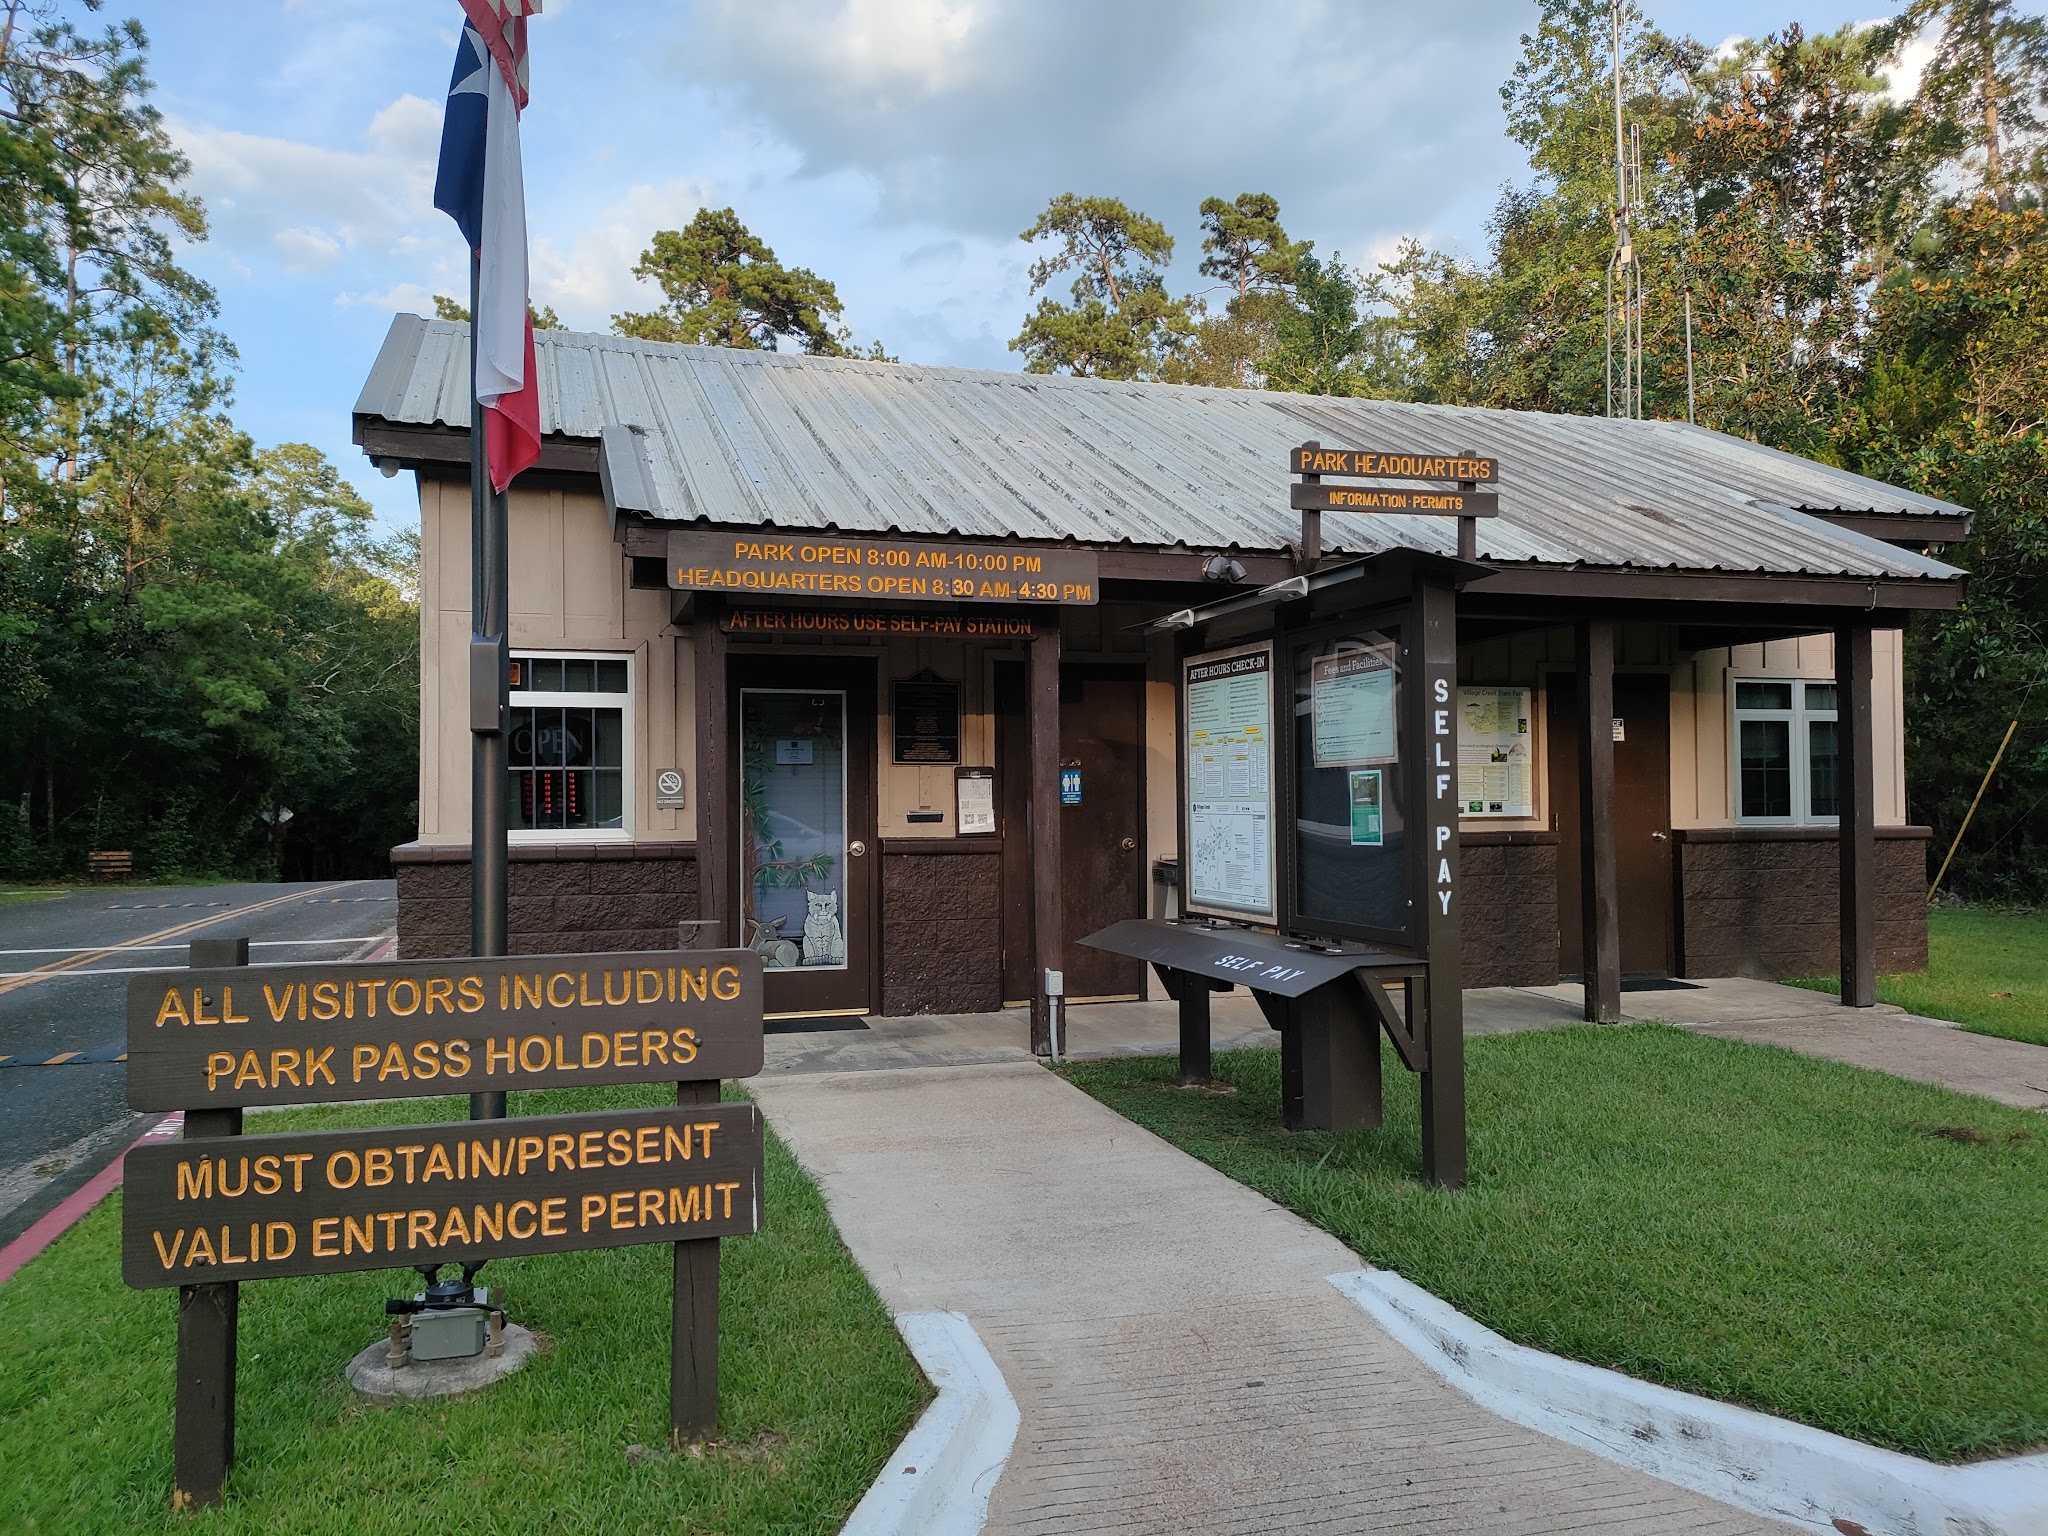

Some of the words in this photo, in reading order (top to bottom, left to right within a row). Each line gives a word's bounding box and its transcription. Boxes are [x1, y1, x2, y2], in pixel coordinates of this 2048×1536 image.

[1301, 451, 1348, 472] PARK
[1354, 454, 1491, 479] HEADQUARTERS
[1329, 491, 1406, 508] INFORMATION
[1412, 495, 1463, 510] PERMITS
[735, 541, 795, 562] PARK
[800, 545, 861, 565] OPEN
[867, 548, 910, 567] 8:00
[915, 551, 1008, 571] AM-10:00
[1013, 555, 1042, 573] PM
[678, 567, 862, 592] HEADQUARTERS
[867, 575, 927, 595] OPEN
[931, 578, 974, 596] 8:30
[979, 580, 1058, 600] AM-4:30
[1062, 583, 1092, 601] PM
[729, 610, 786, 630] AFTER
[790, 612, 850, 631] HOURS
[853, 613, 887, 632] USE
[890, 615, 963, 633] SELF-PAY
[966, 617, 1032, 635] STATION
[1190, 667, 1209, 680] AFTER
[1209, 663, 1231, 677] HOURS
[1231, 656, 1266, 673] CHECK-IN
[1324, 665, 1339, 676] Fees
[1340, 660, 1352, 673] and
[1352, 656, 1383, 671] Facilities
[1463, 689, 1481, 697] Village
[514, 728, 584, 755] OPEN
[1434, 678, 1451, 799] SELF
[1436, 826, 1452, 915] PAY
[1214, 955, 1264, 971] SELF
[1259, 965, 1306, 982] PAY
[156, 986, 249, 1028] ALL
[264, 974, 485, 1024] VISITORS
[499, 965, 742, 1011] INCLUDING
[206, 1045, 337, 1092] PARK
[352, 1038, 472, 1084] PASS
[485, 1027, 700, 1076] HOLDERS
[176, 1153, 314, 1201] MUST
[326, 1121, 722, 1190] OBTAIN/PRESENT
[153, 1220, 298, 1270] VALID
[312, 1197, 568, 1258] ENTRANCE
[580, 1181, 741, 1234] PERMIT
